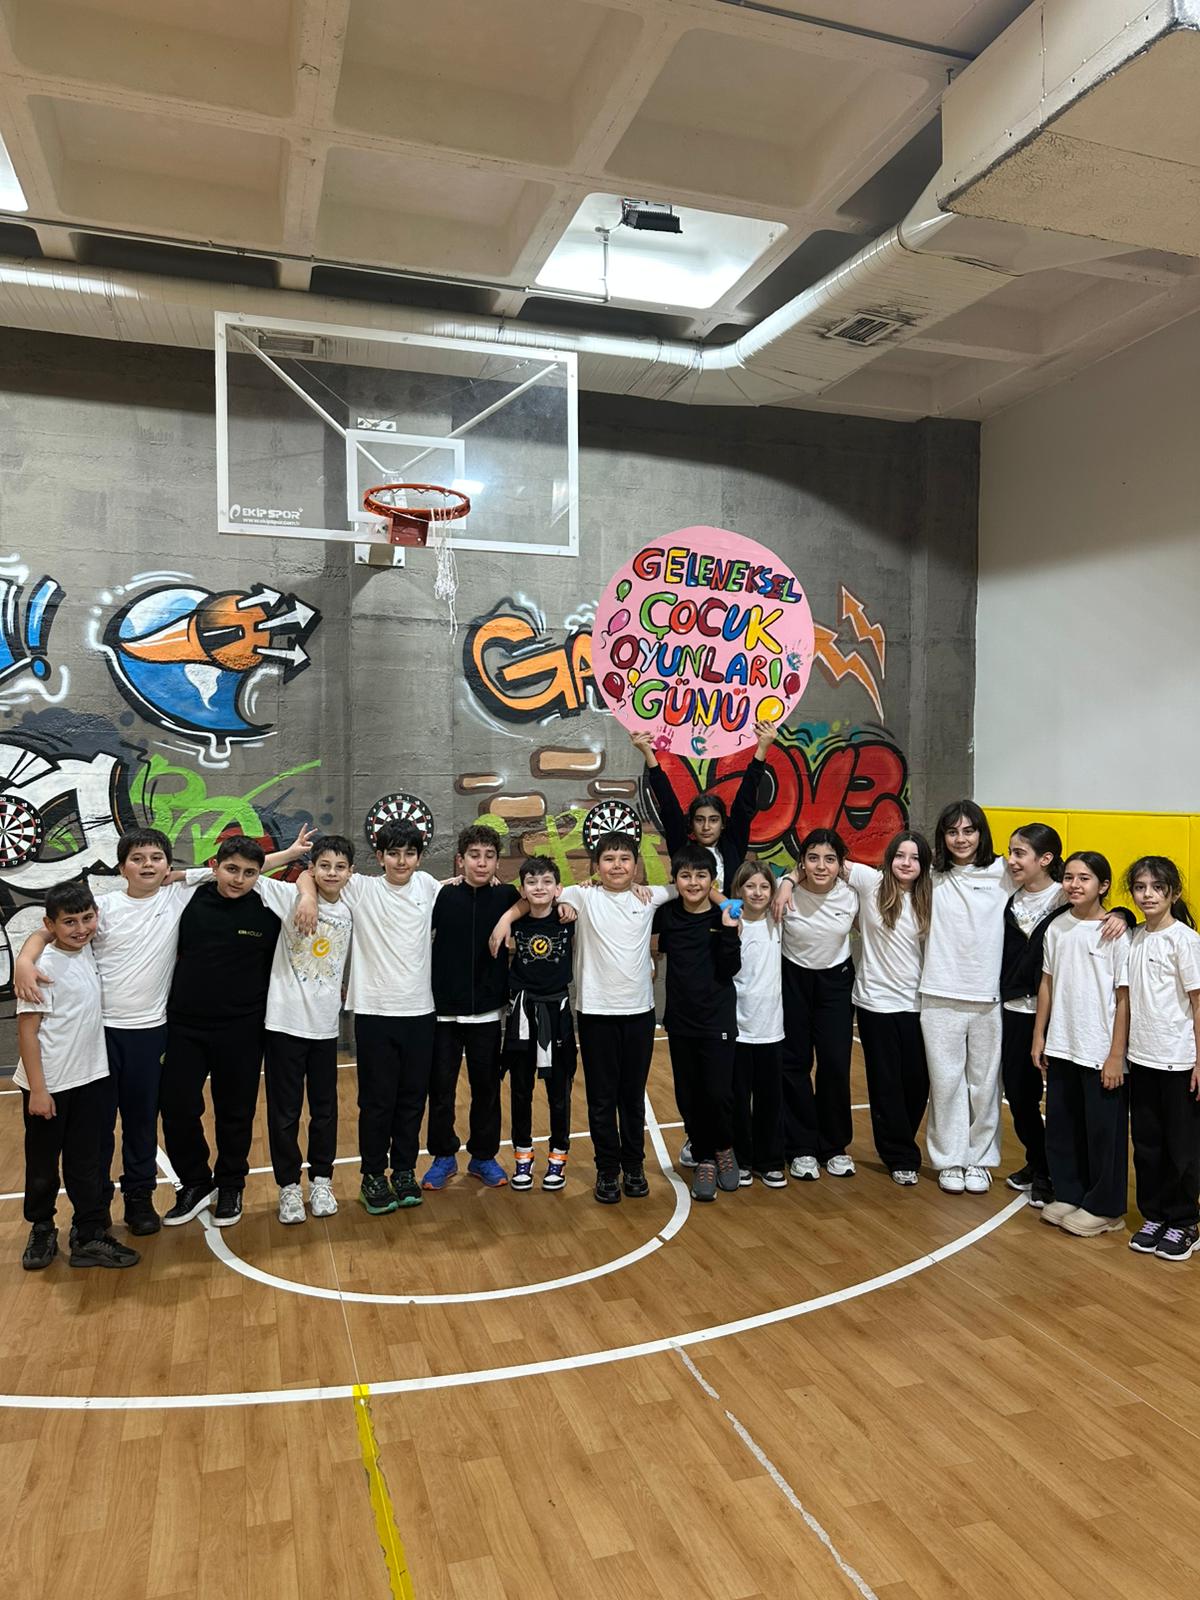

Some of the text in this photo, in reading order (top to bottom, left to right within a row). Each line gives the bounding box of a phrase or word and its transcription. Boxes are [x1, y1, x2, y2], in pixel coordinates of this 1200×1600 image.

[633, 547, 802, 604] GELENEKSEL
[640, 591, 783, 654] ÇOCUK
[610, 634, 782, 689] OYUNLARI
[632, 677, 750, 732] GÜNÜ
